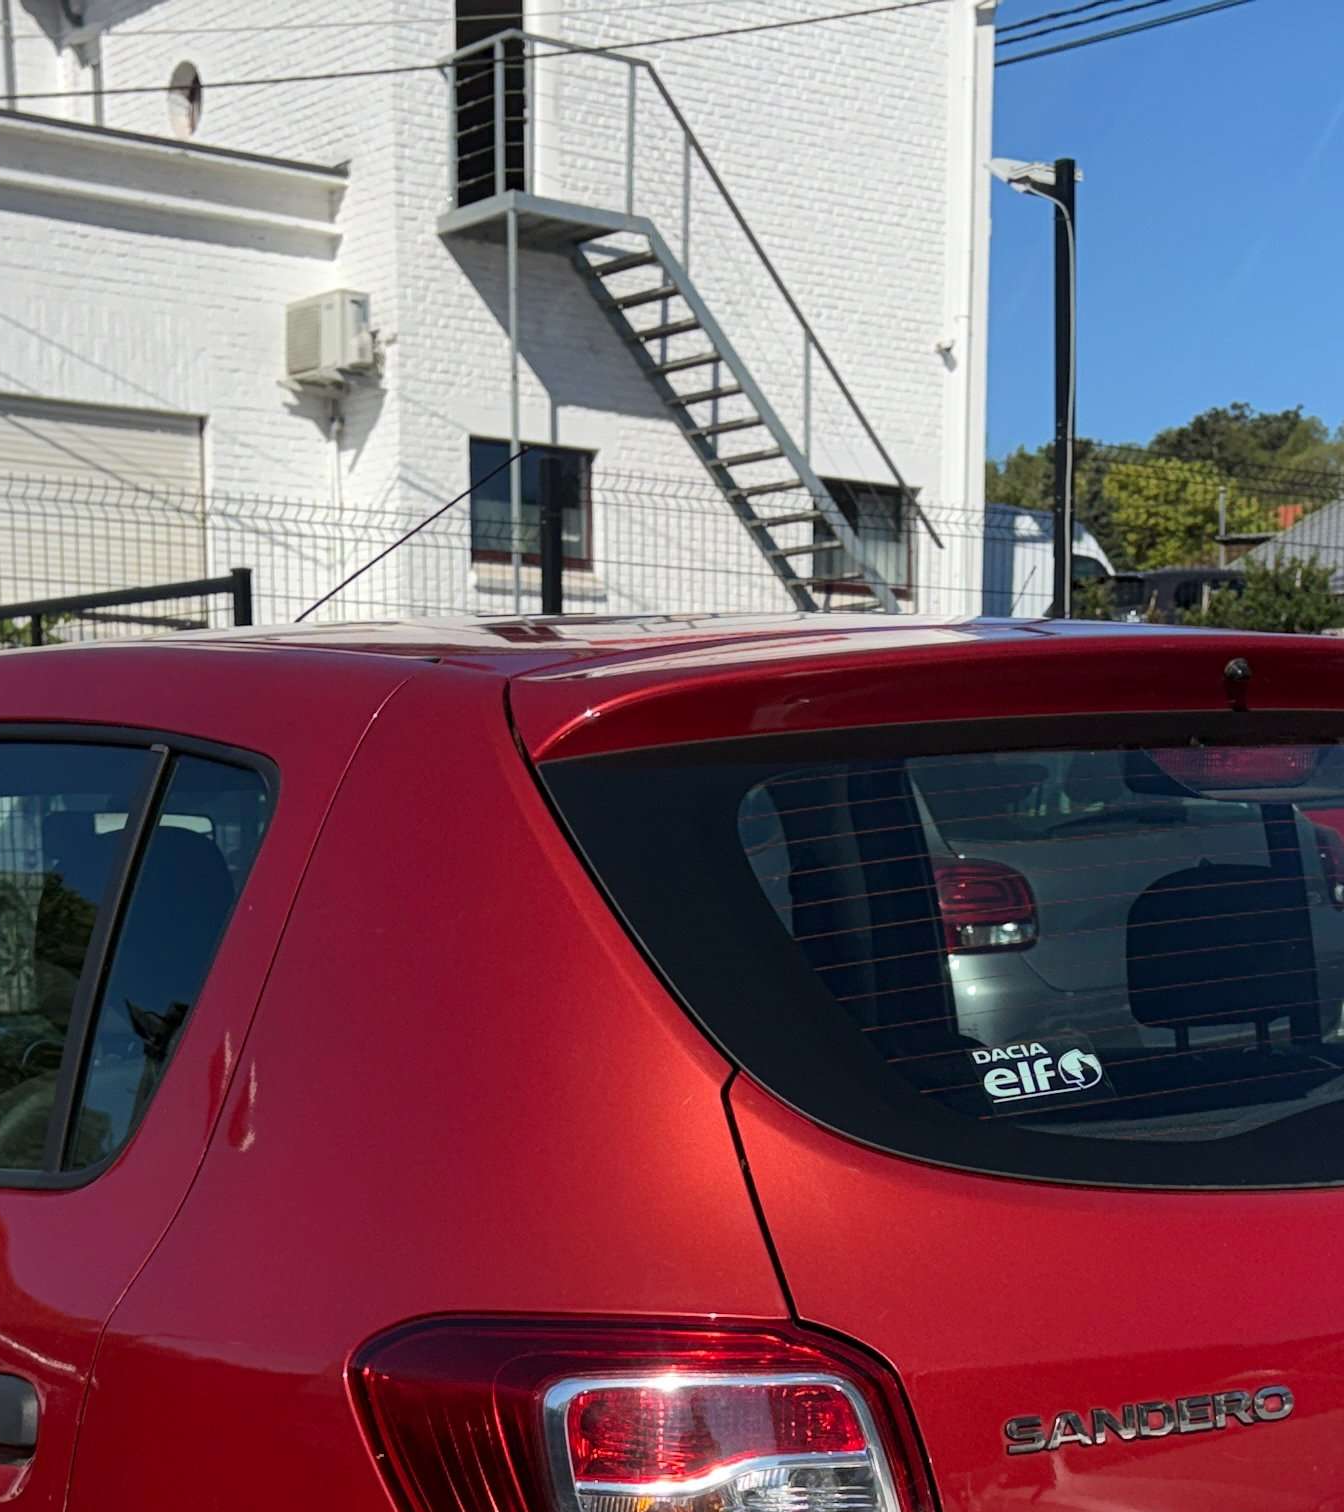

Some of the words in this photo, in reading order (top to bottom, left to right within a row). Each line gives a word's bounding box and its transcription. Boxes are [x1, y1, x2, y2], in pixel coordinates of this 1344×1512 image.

[972, 1042, 1049, 1065] DACIA
[983, 1057, 1057, 1098] elf
[1004, 1383, 1296, 1456] SANDERO
